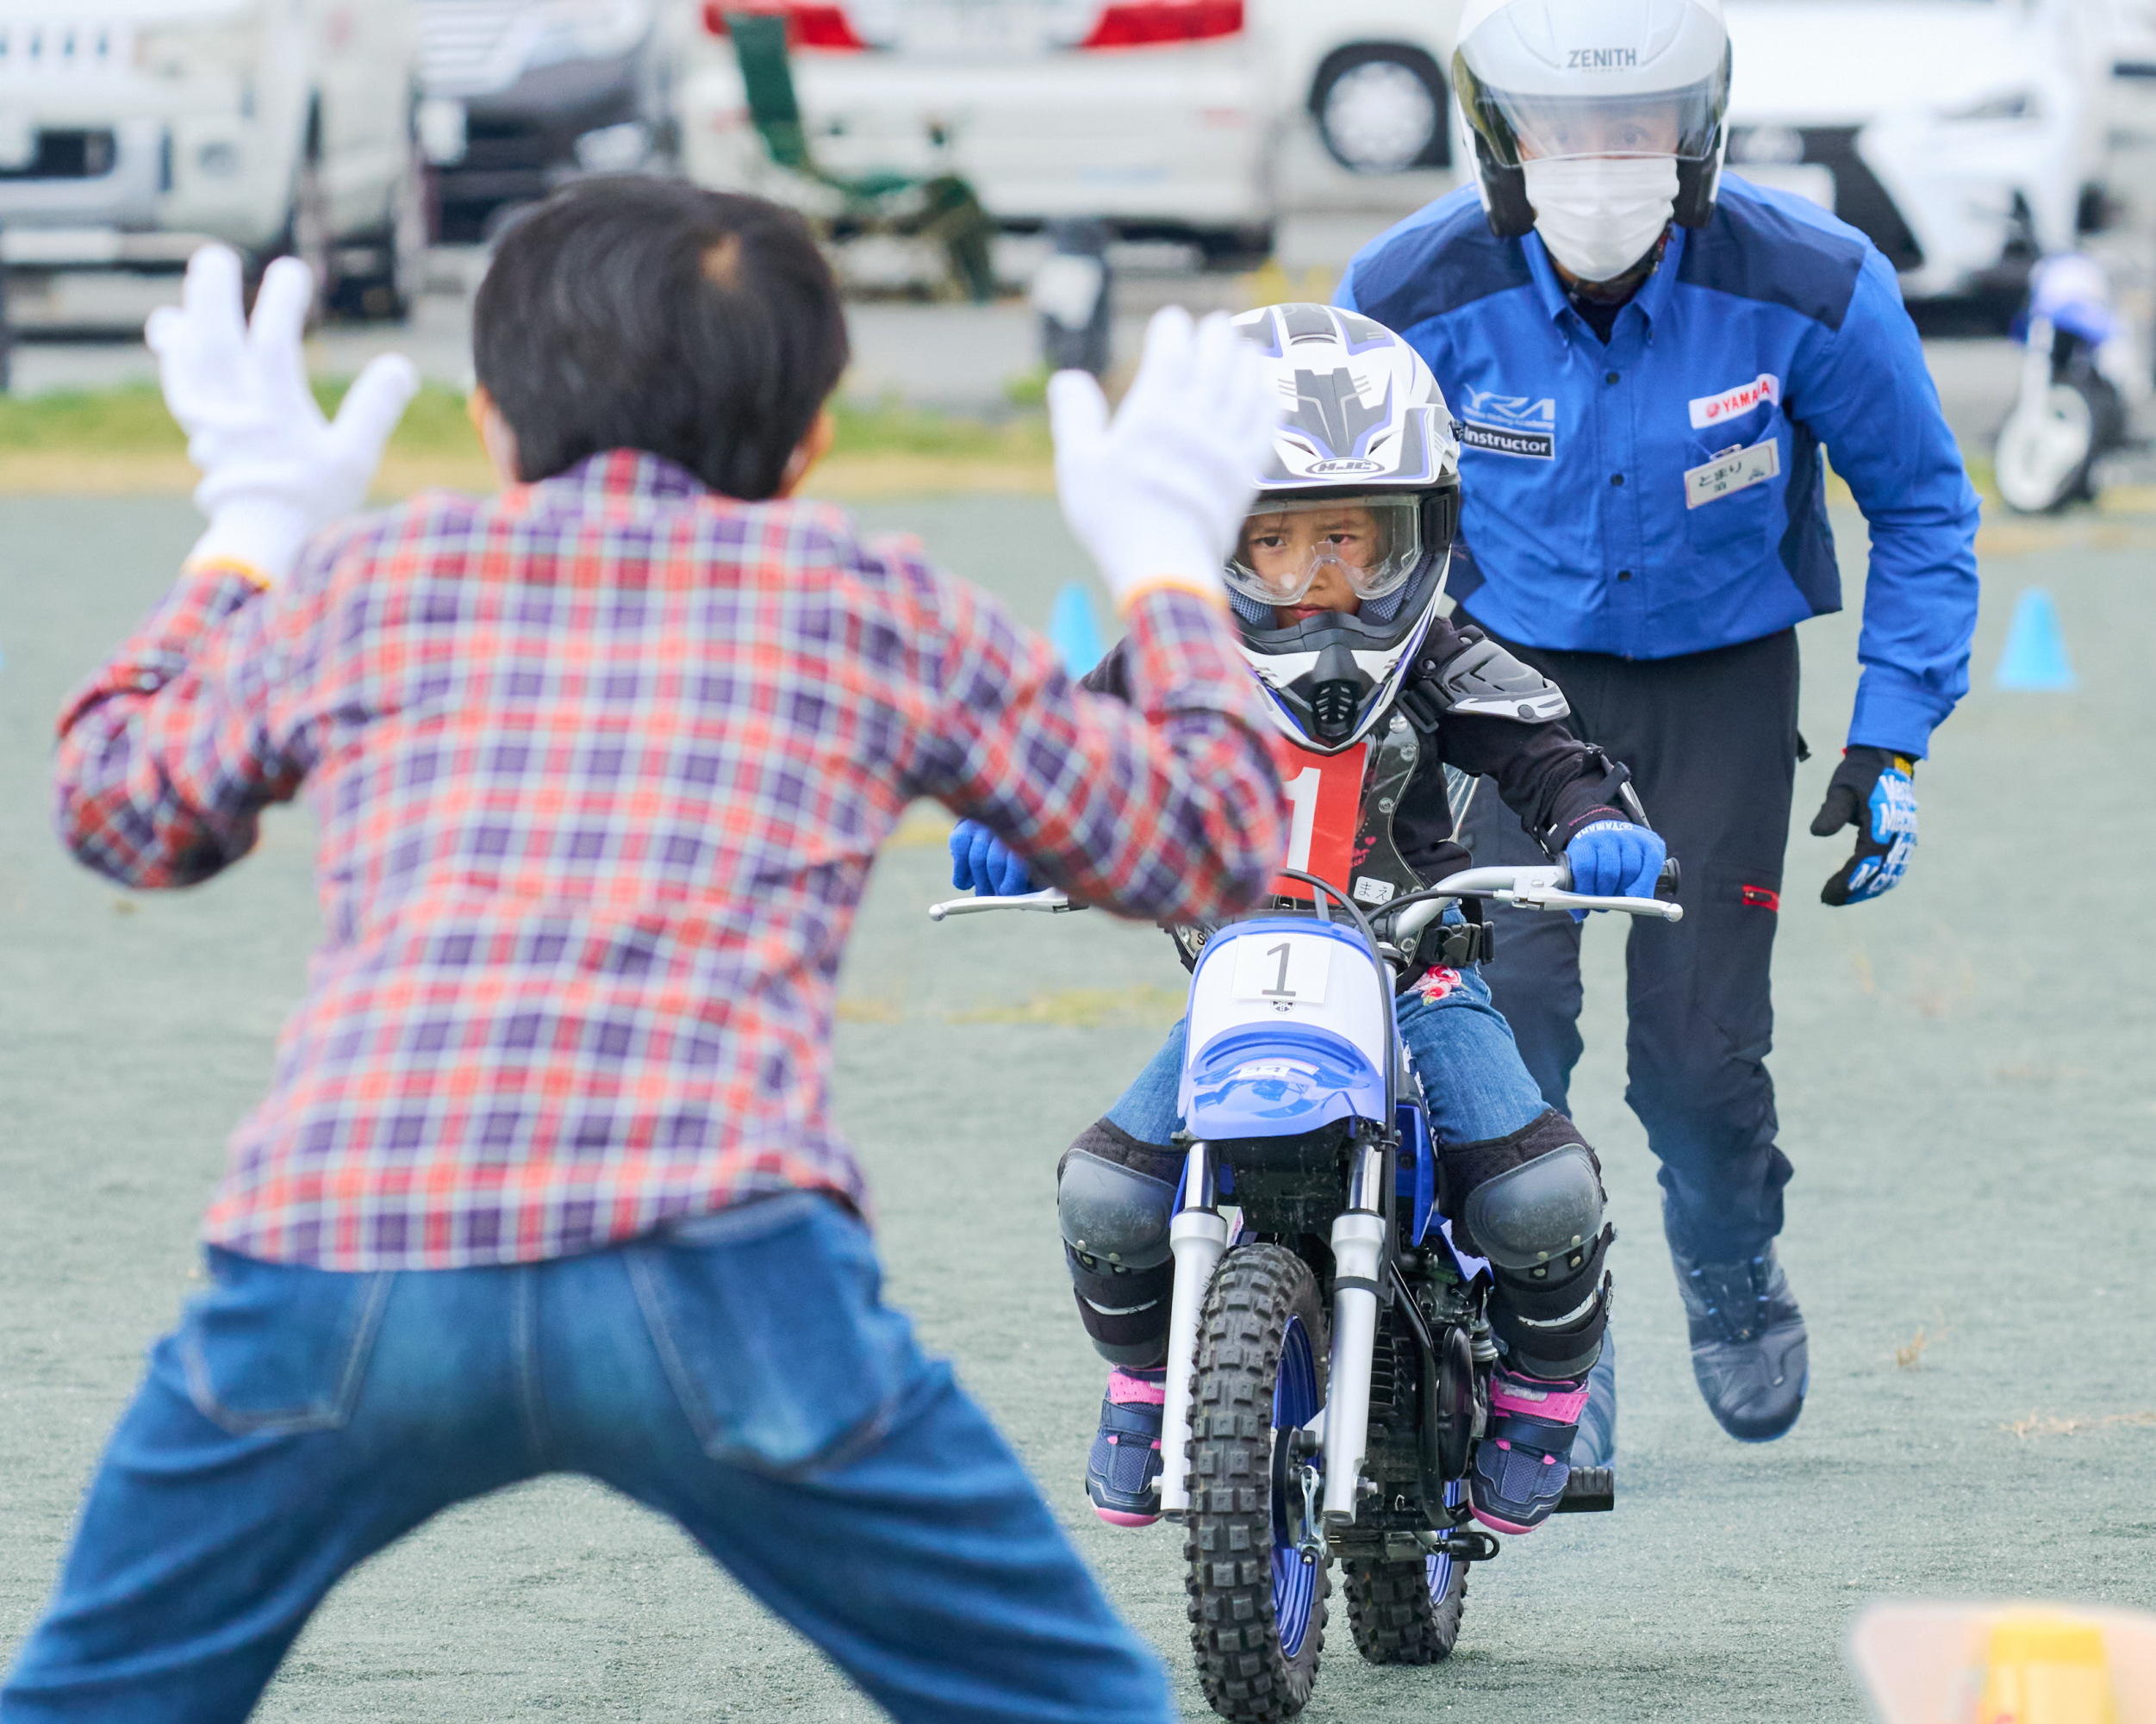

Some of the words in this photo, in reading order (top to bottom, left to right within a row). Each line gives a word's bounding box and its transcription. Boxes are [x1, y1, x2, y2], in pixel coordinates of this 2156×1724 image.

[1567, 48, 1636, 67] ZENITH
[1723, 381, 1770, 412] YAMAA
[1465, 426, 1548, 452] Instructor
[1318, 462, 1371, 471] HJC
[1282, 766, 1322, 873] 1
[1359, 881, 1388, 902] まえ
[1262, 943, 1296, 997] 1
